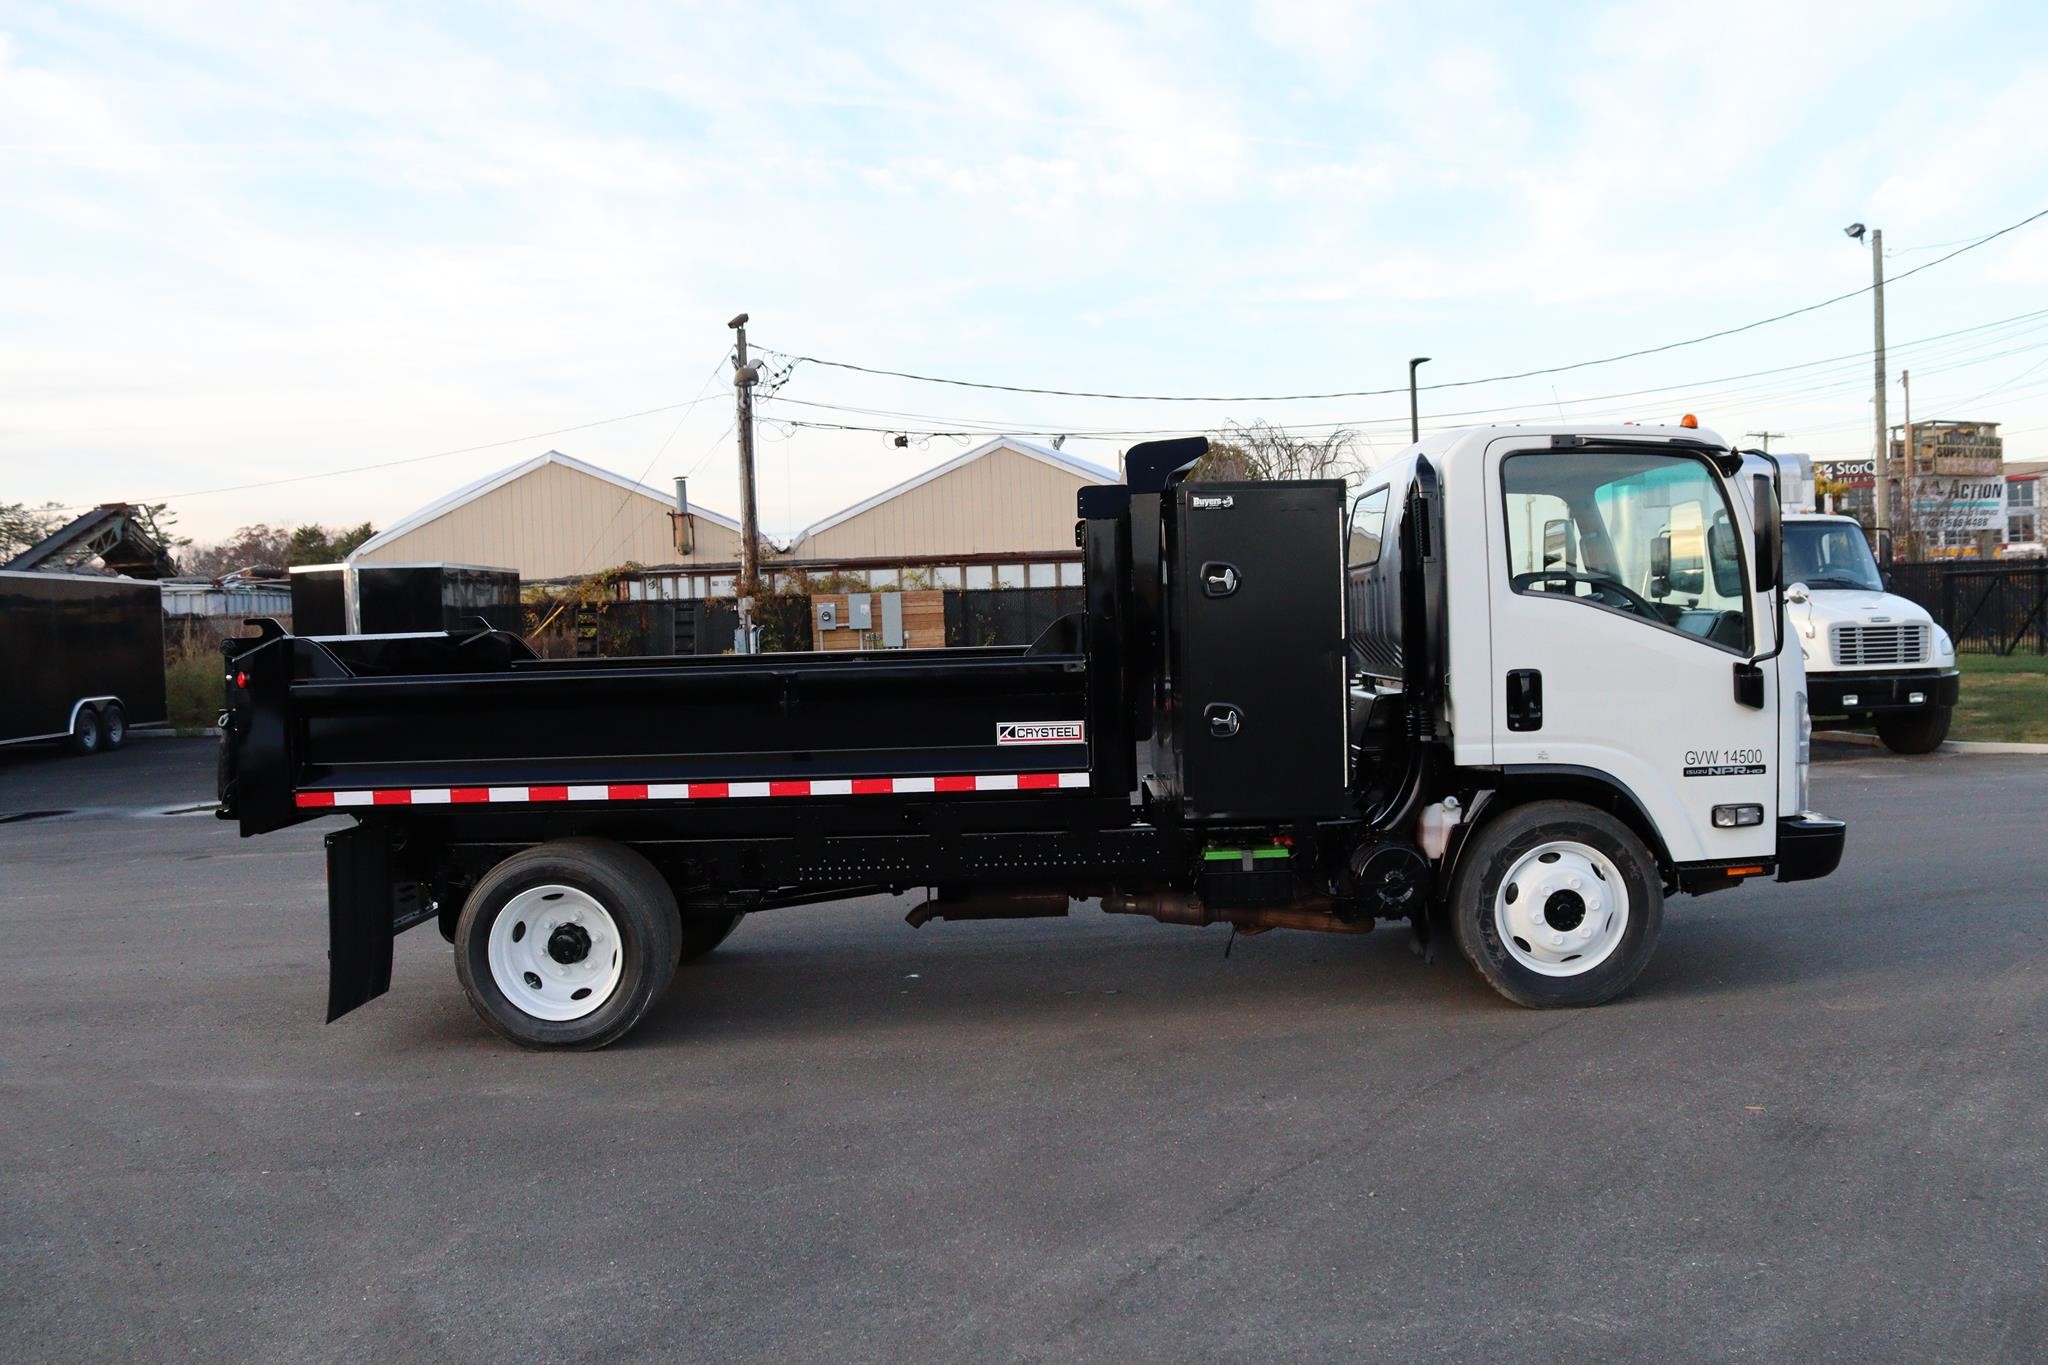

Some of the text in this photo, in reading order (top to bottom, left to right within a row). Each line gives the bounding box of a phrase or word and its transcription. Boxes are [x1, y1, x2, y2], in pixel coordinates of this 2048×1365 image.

[1937, 447, 1974, 458] SUPPLY
[1193, 497, 1222, 507] Buyers
[1016, 726, 1079, 738] CRYSTEEL
[1684, 749, 1763, 765] GVW 14500
